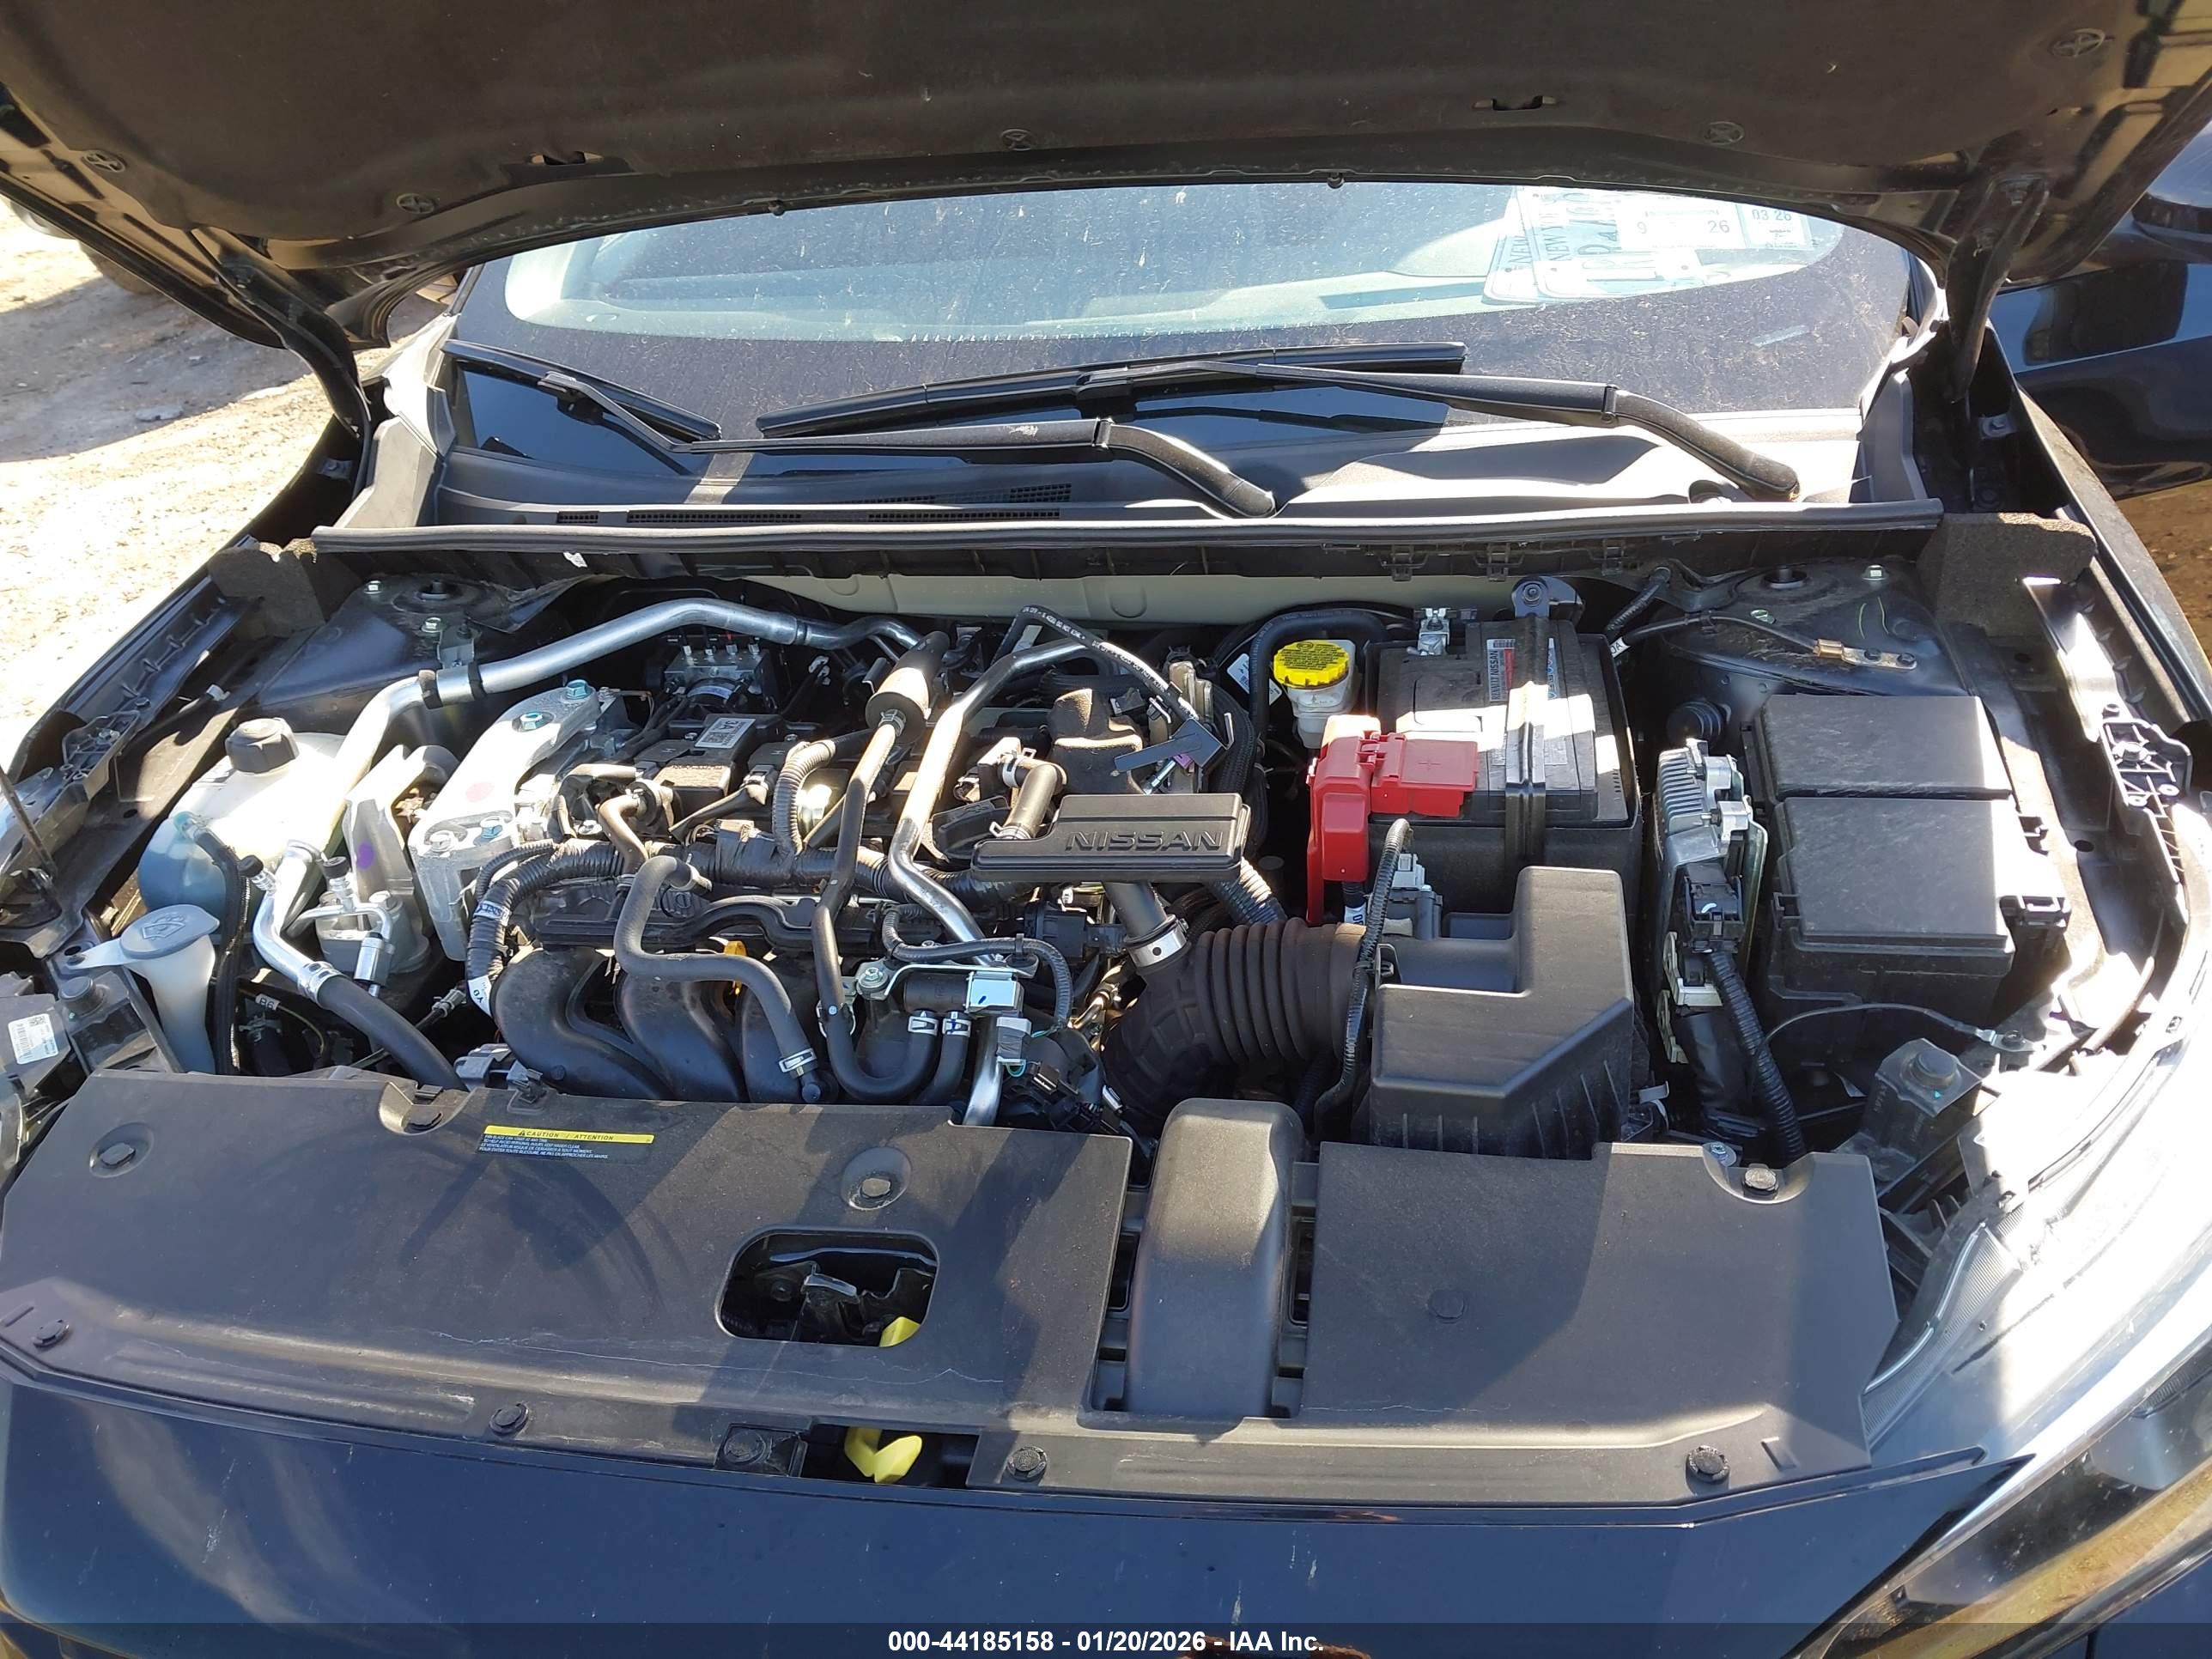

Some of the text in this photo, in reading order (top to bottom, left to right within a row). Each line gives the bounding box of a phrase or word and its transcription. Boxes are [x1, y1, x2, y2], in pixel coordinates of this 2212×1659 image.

[1706, 219, 1730, 234] 26
[1490, 650, 1498, 676] NISSAN
[1491, 676, 1501, 701] RENAULT
[1065, 830, 1224, 851] NISSAN
